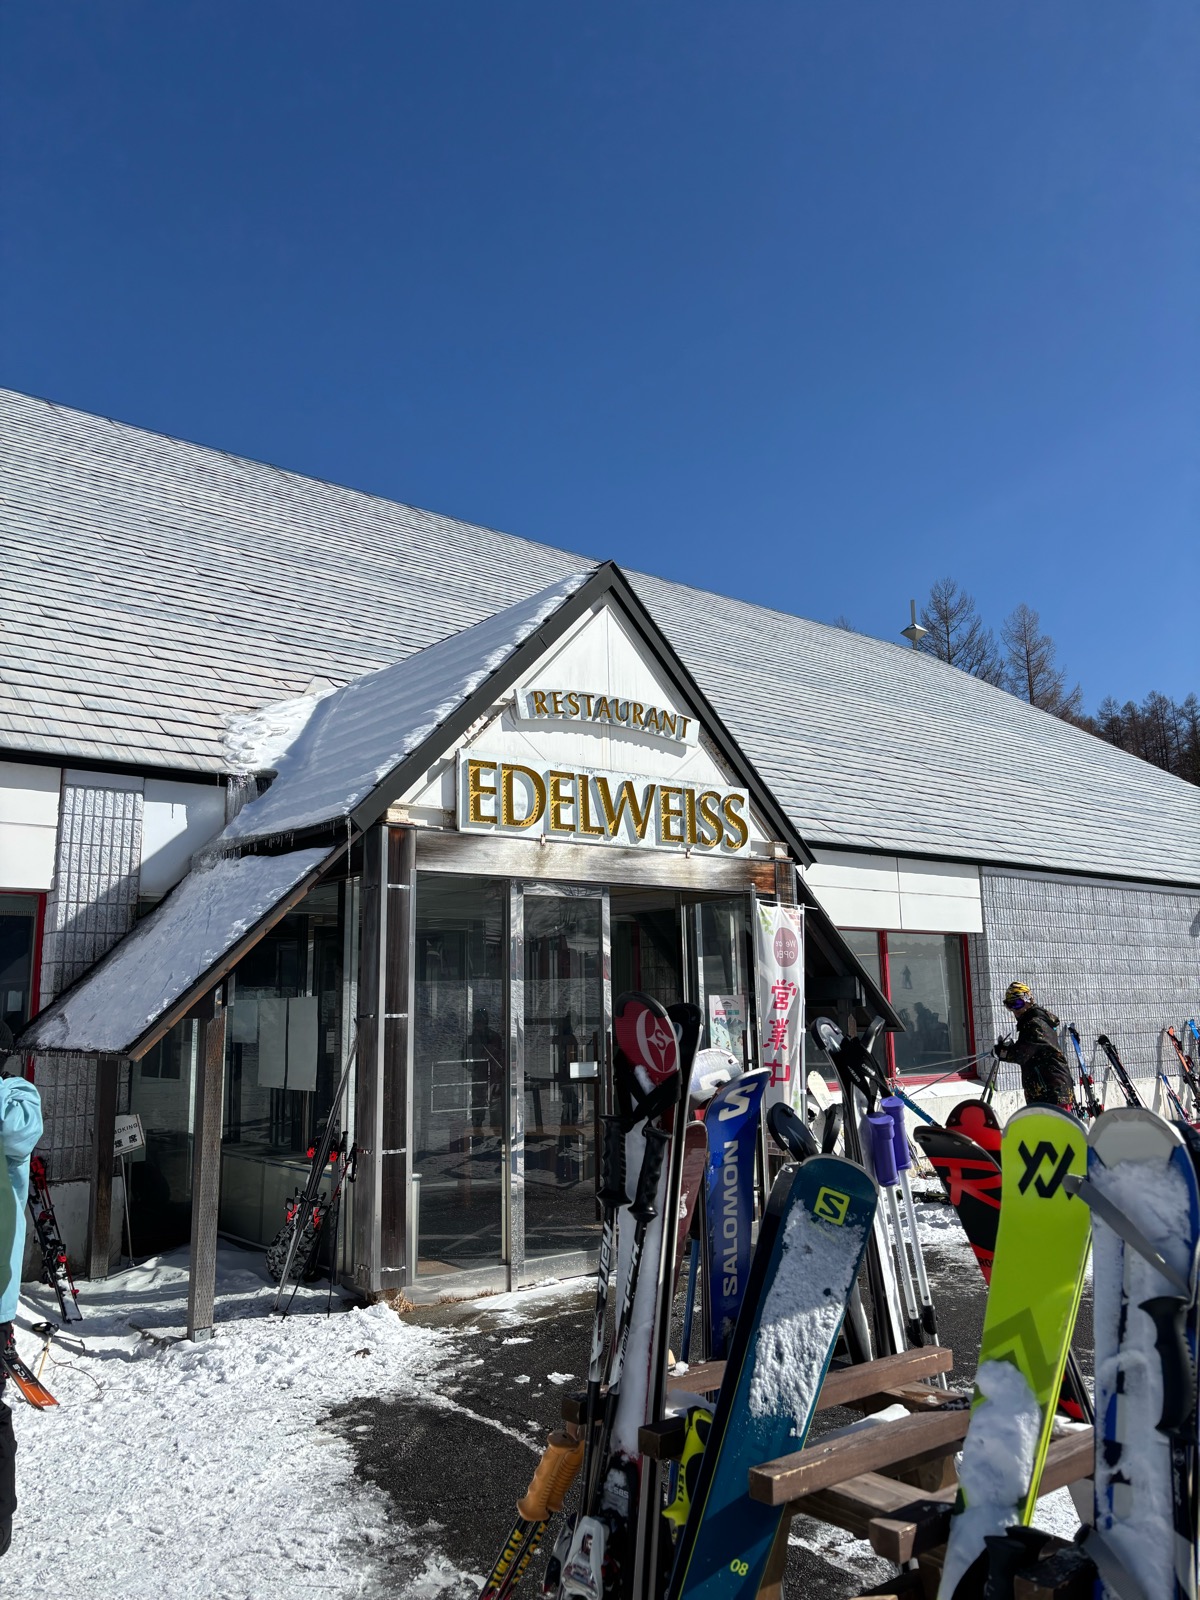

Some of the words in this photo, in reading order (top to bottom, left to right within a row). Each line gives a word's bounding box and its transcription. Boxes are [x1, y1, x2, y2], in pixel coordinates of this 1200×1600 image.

[532, 690, 691, 738] RESTAURANT
[468, 758, 748, 850] EDELWEISS
[723, 1140, 738, 1297] SALOMON
[977, 1256, 994, 1268] RO
[731, 1559, 749, 1576] 08
